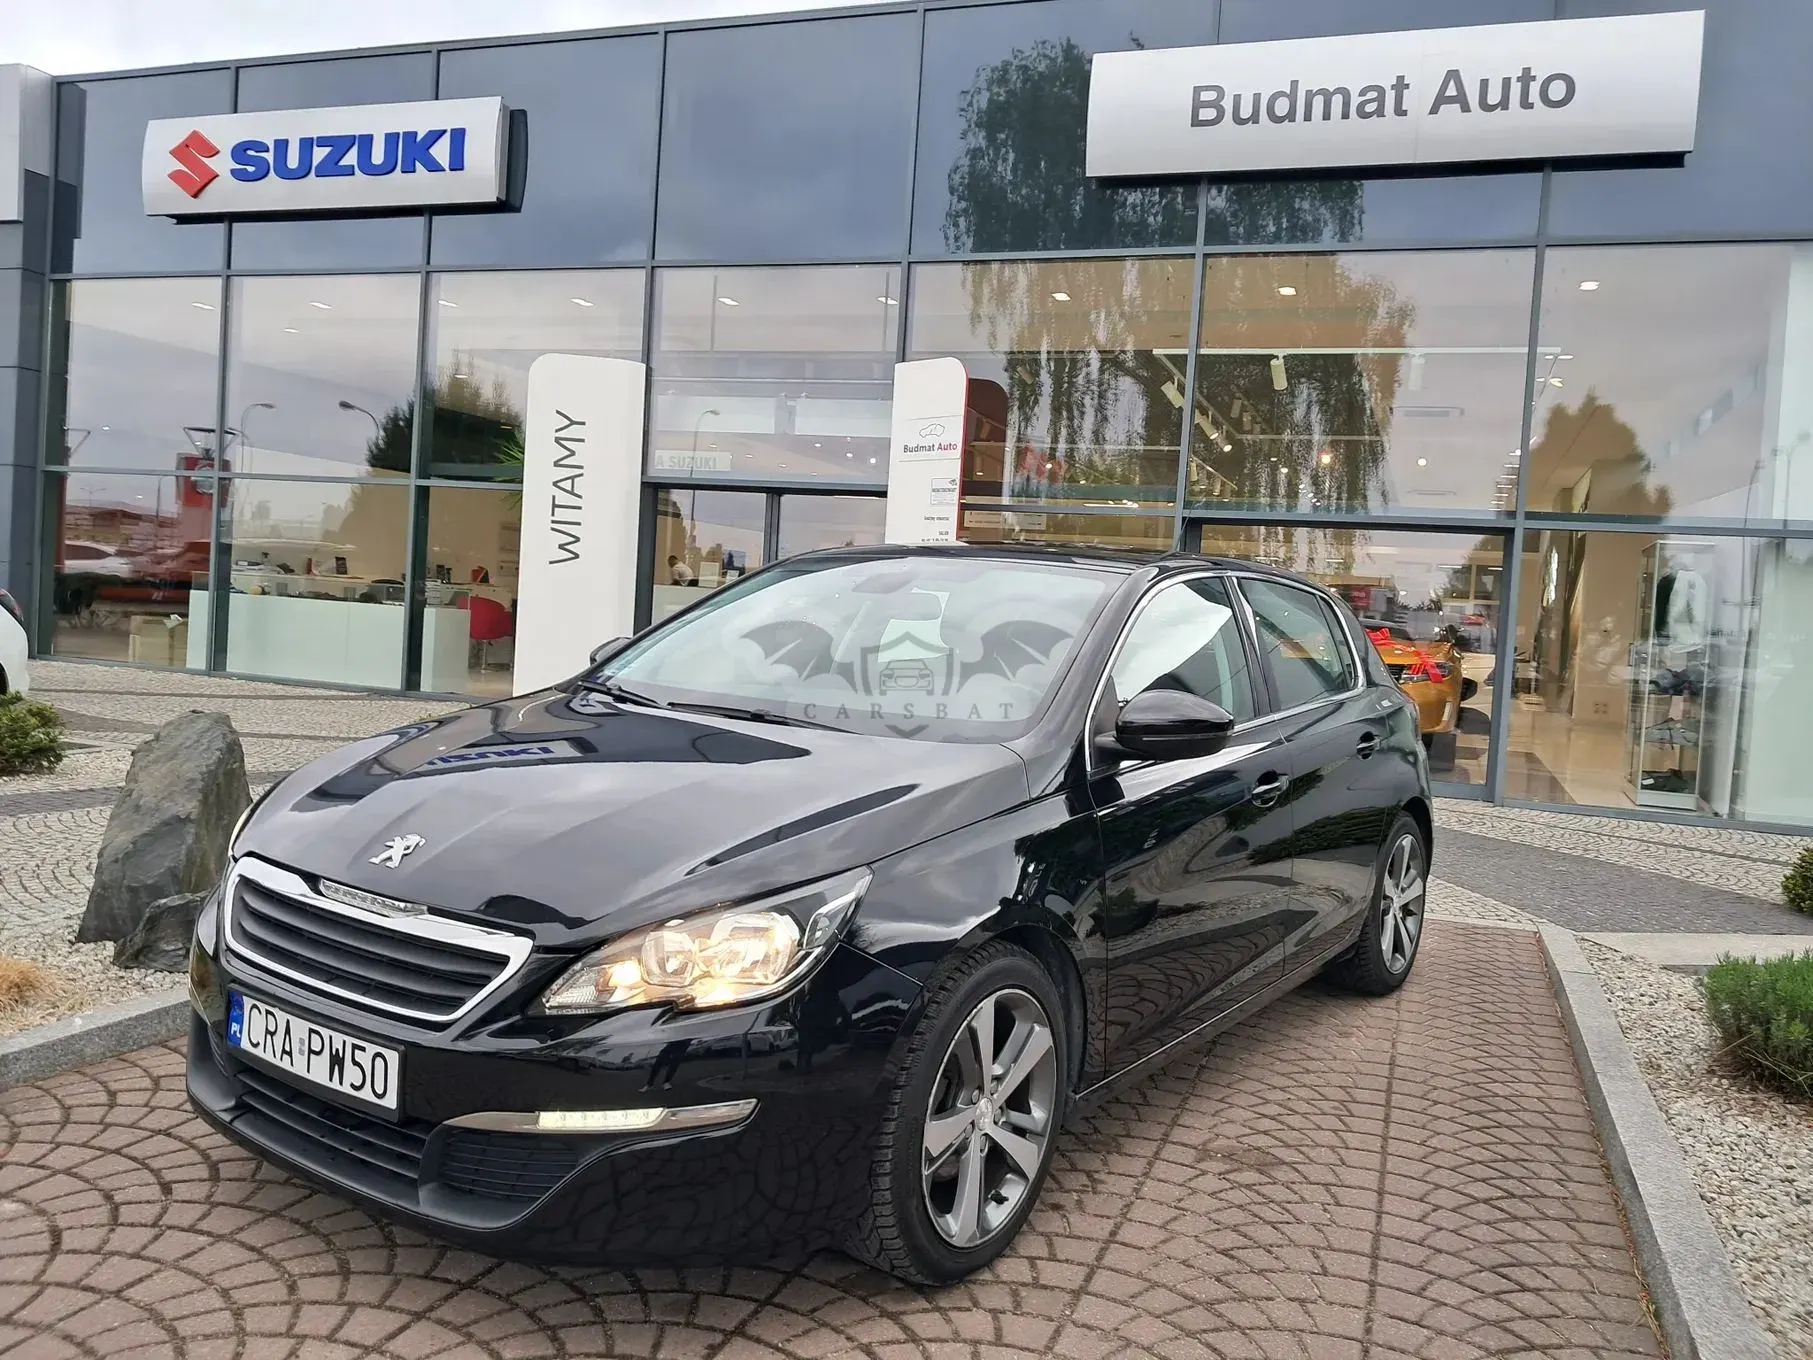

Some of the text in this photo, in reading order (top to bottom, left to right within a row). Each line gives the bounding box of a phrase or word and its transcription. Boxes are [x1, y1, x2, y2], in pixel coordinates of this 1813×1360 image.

[1190, 66, 1577, 128] Budmat Auto
[229, 127, 466, 183] SUZUKI
[668, 455, 717, 469] SUZUKI
[903, 442, 958, 453] Budmat Auto
[548, 409, 586, 565] WITAMY
[231, 1021, 241, 1037] PL
[247, 1003, 388, 1099] CRA PW50
